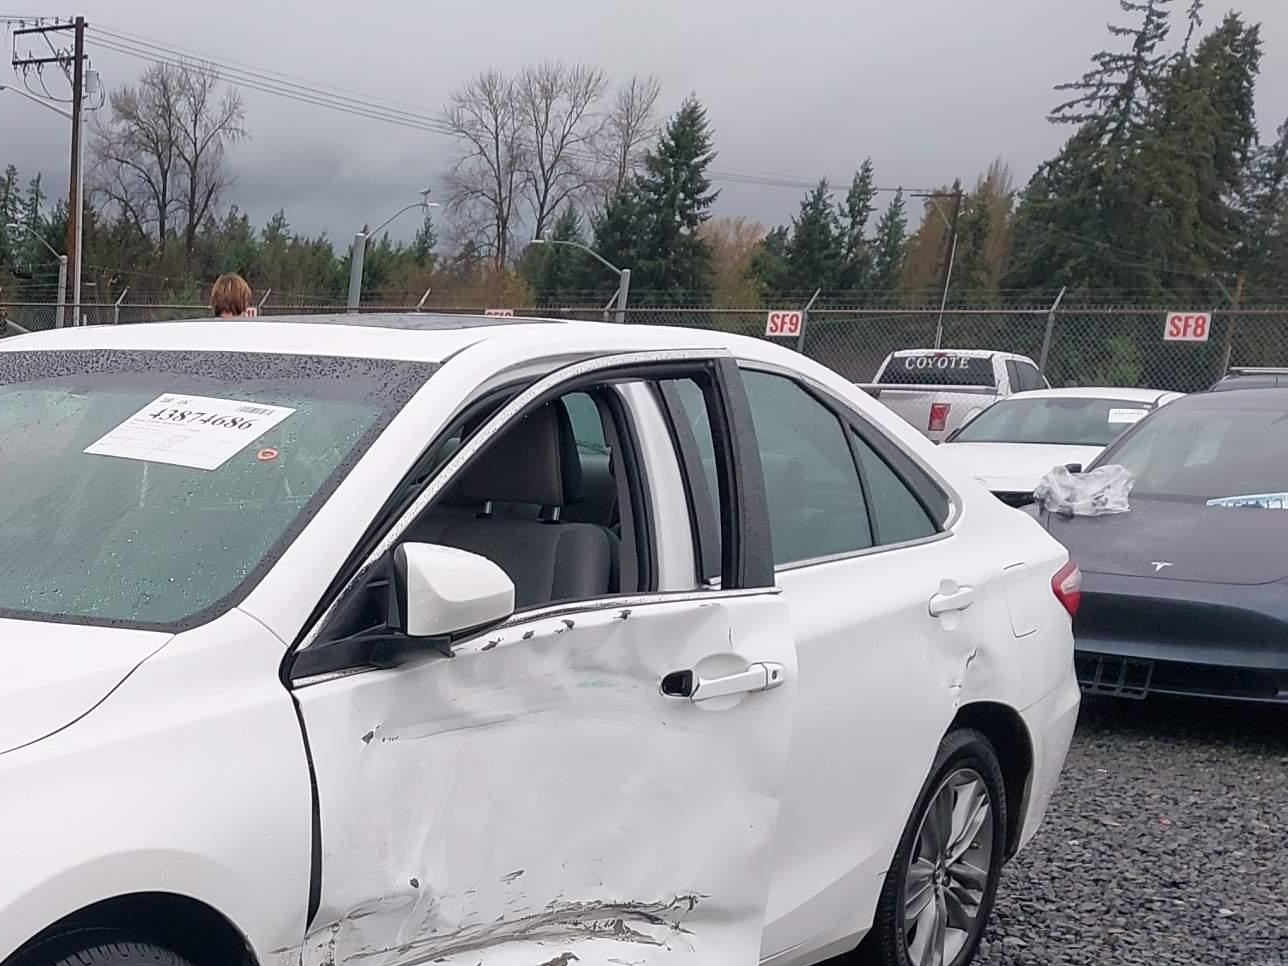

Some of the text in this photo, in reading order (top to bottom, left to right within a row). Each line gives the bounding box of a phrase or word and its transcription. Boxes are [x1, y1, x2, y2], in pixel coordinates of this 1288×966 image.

[769, 313, 800, 333] SF9
[1168, 315, 1207, 337] SF8
[905, 356, 970, 370] COYOTE
[148, 408, 257, 430] 43874686
